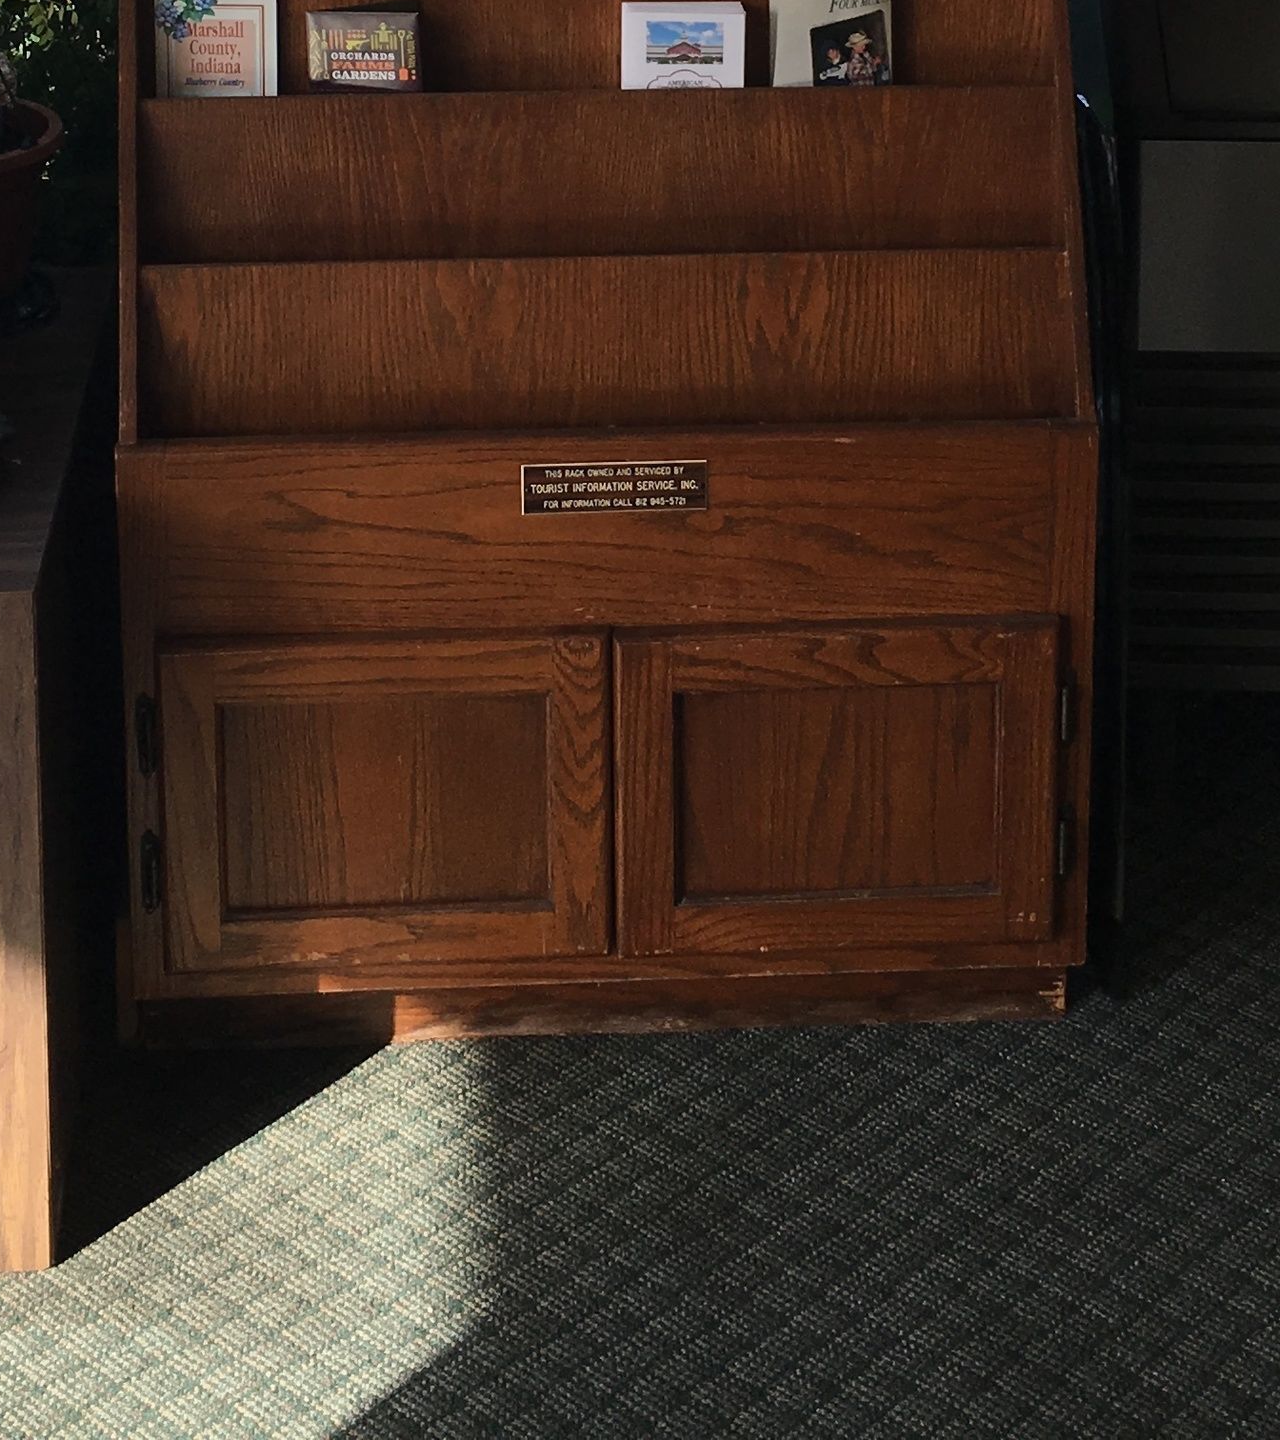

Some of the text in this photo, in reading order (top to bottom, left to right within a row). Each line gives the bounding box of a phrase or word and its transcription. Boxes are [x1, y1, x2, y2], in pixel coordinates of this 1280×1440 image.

[187, 21, 244, 38] Marshall
[189, 40, 241, 59] County,
[330, 52, 396, 61] ORCHARDS
[190, 58, 241, 74] Indiana
[331, 61, 395, 70] FARMS
[331, 70, 396, 80] GARDENS
[545, 466, 684, 478] THIS RACK OWNED AND SERVICED BY
[530, 483, 569, 494] TOURIST
[572, 481, 633, 493] INFORMATION
[680, 480, 699, 490] INC.
[543, 500, 559, 509] FOR
[561, 499, 611, 508] INFORMATION
[613, 498, 633, 507] CALL
